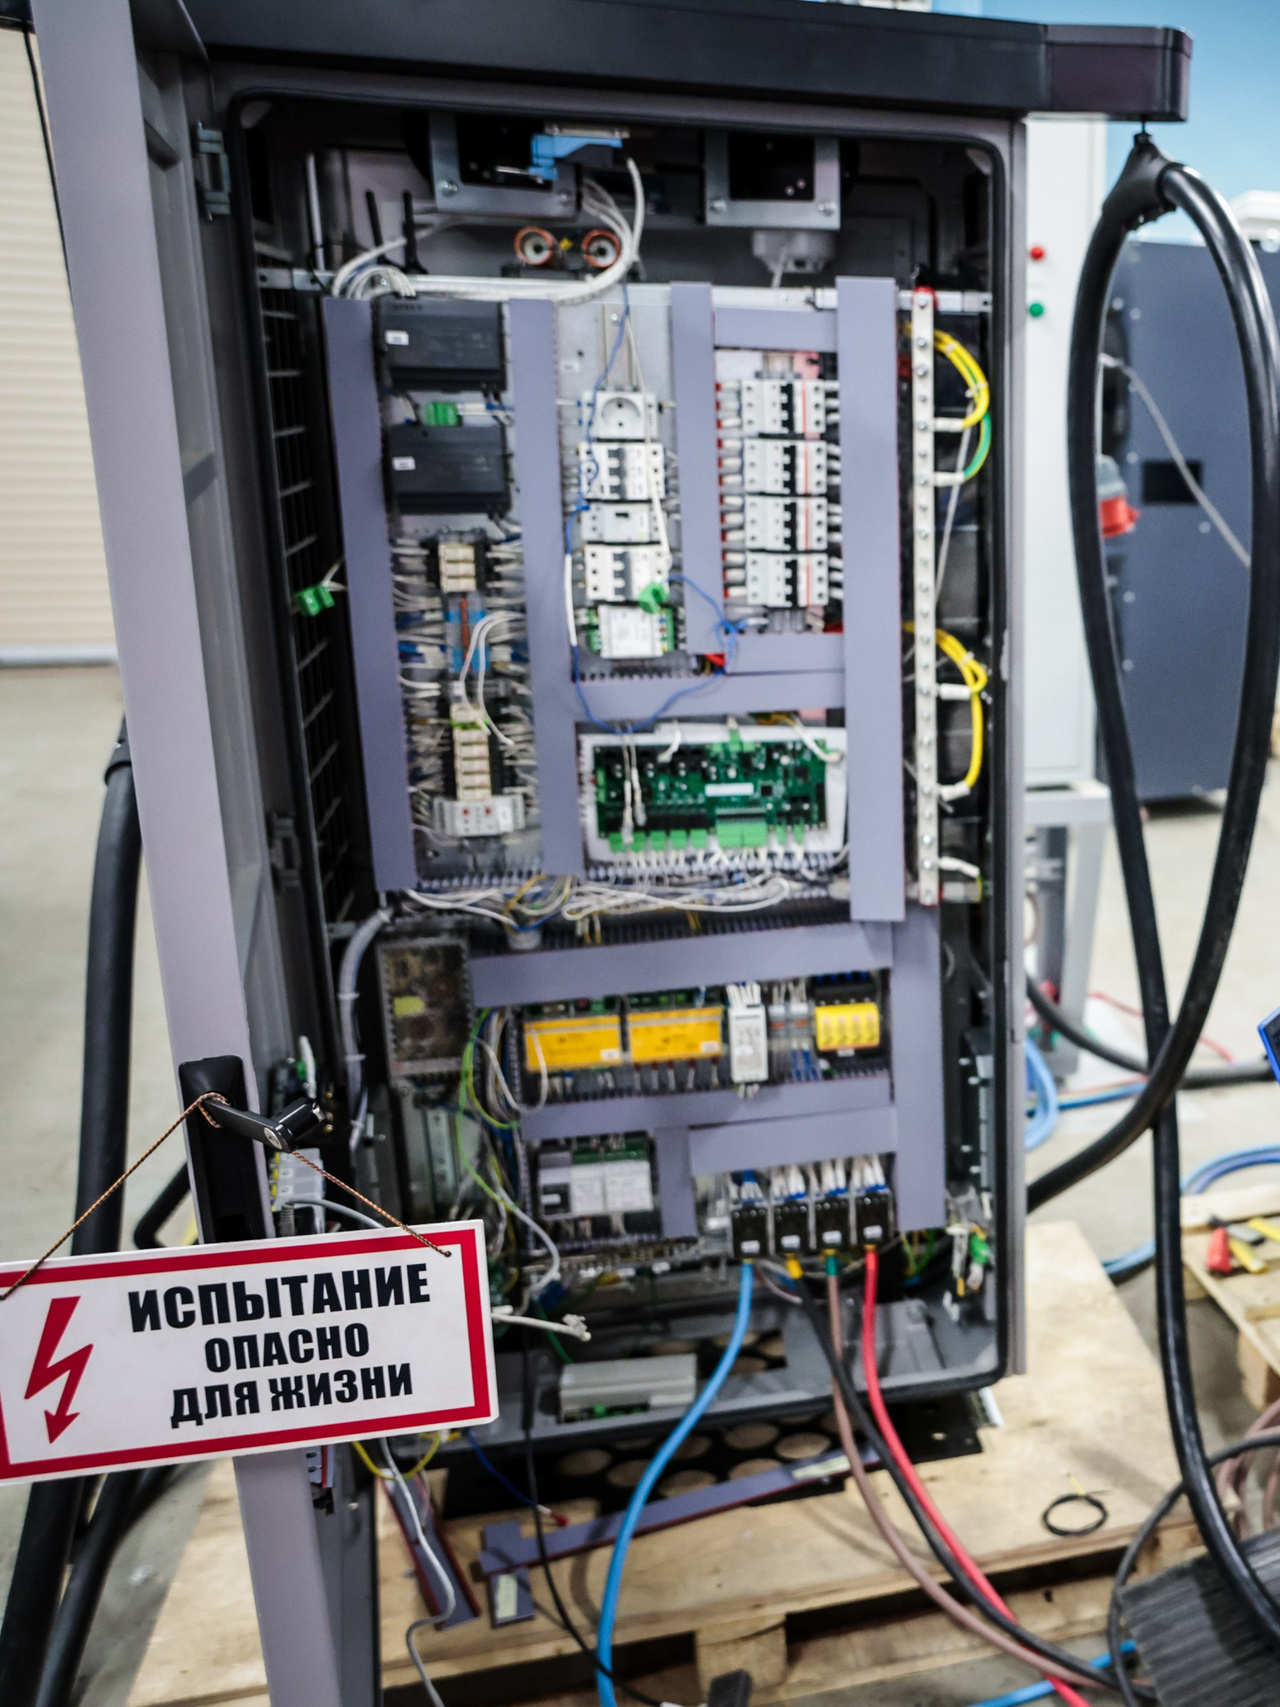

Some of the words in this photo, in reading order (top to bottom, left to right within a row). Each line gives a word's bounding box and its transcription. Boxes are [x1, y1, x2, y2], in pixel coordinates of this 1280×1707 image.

[127, 1262, 431, 1333] ИСПЫТАНИЕ
[204, 1322, 370, 1373] ОПАСНО
[170, 1380, 260, 1429] ДЛЯ
[269, 1362, 413, 1412] ЖИЗНИ
